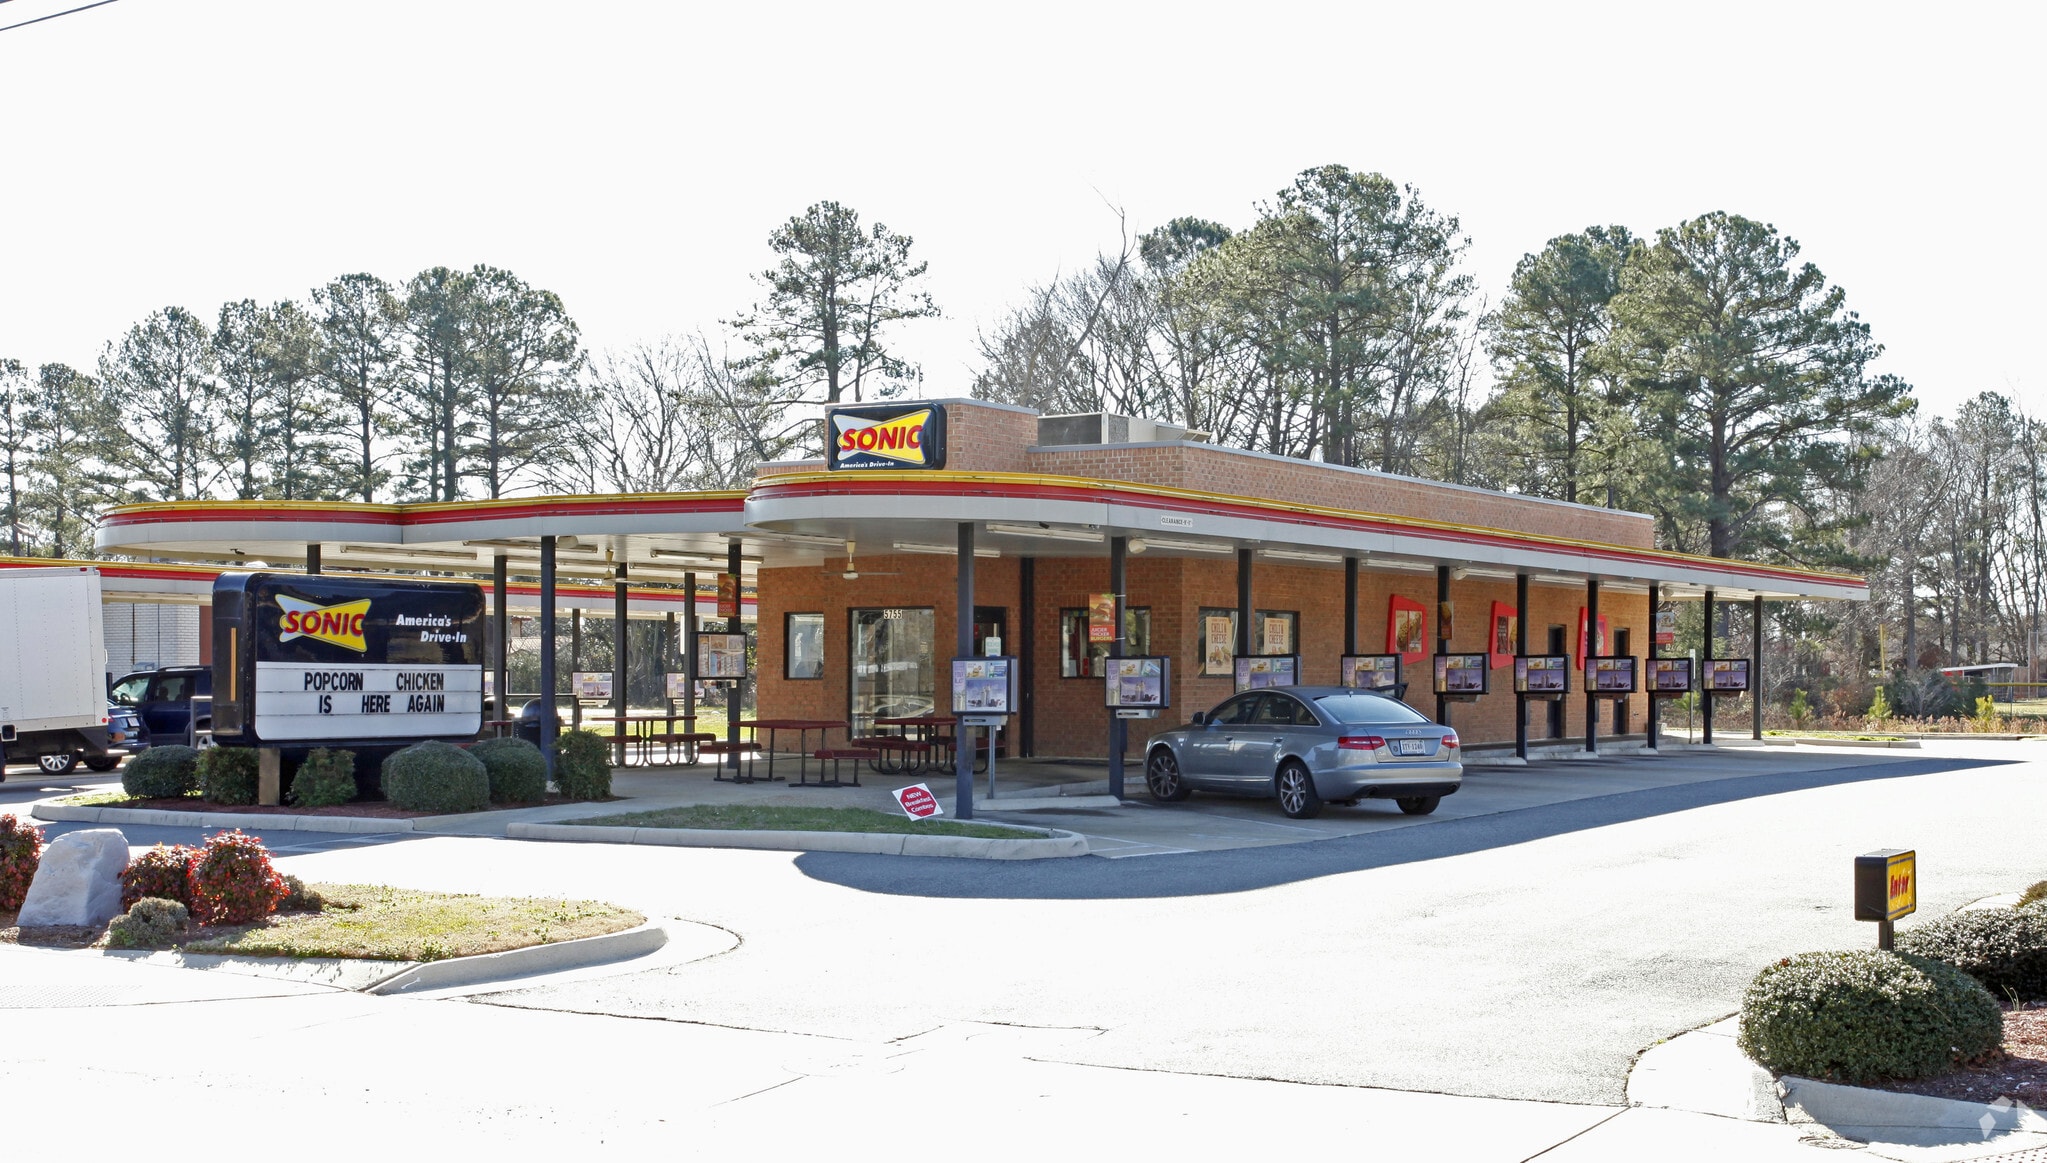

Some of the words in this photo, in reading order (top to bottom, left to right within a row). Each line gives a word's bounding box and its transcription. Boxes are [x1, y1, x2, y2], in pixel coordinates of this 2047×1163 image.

[841, 425, 923, 451] SONIC
[840, 461, 868, 469] America's
[396, 613, 451, 627] America's
[884, 609, 902, 619] 5755
[284, 610, 365, 636] SONIC
[304, 672, 363, 691] POPCORN
[396, 672, 444, 691] CHICKEN
[319, 695, 332, 713] IS
[361, 695, 391, 713] HERE
[407, 695, 444, 712] AGAIN
[905, 797, 931, 807] Breakfast
[906, 791, 922, 799] NEW
